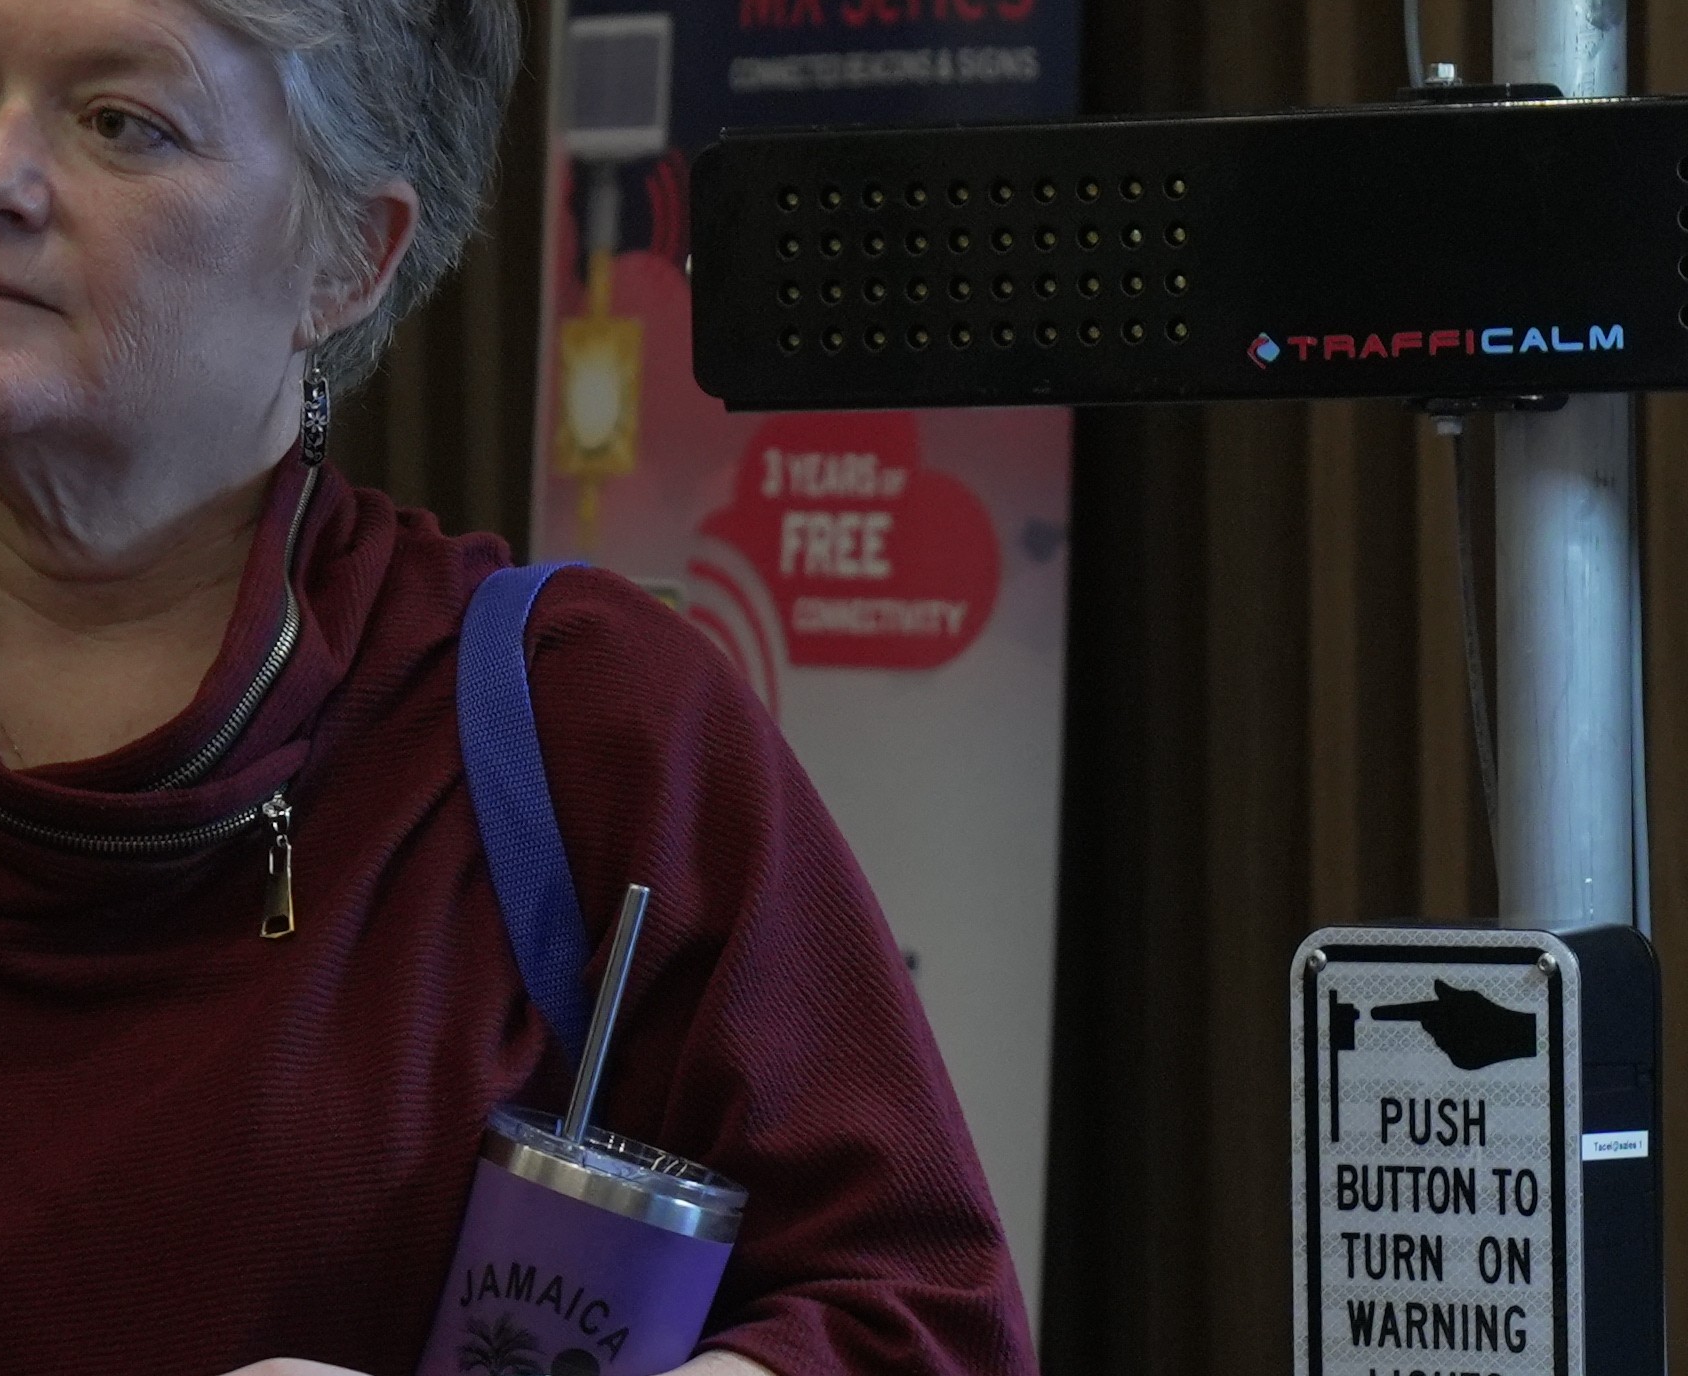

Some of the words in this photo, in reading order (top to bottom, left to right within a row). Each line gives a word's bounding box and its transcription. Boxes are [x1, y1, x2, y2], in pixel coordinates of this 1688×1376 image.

[1287, 324, 1624, 362] TRAFFICALM
[760, 454, 780, 499] 3
[784, 450, 877, 496] YEARS
[779, 509, 894, 580] FREE
[1381, 1097, 1486, 1147] PUSH
[1337, 1164, 1476, 1215] BUTTON
[1492, 1168, 1538, 1216] TO
[1340, 1232, 1443, 1282] TURN
[1478, 1236, 1531, 1285] ON
[460, 1261, 629, 1362] JAMAICA
[1347, 1300, 1527, 1355] WARNING
